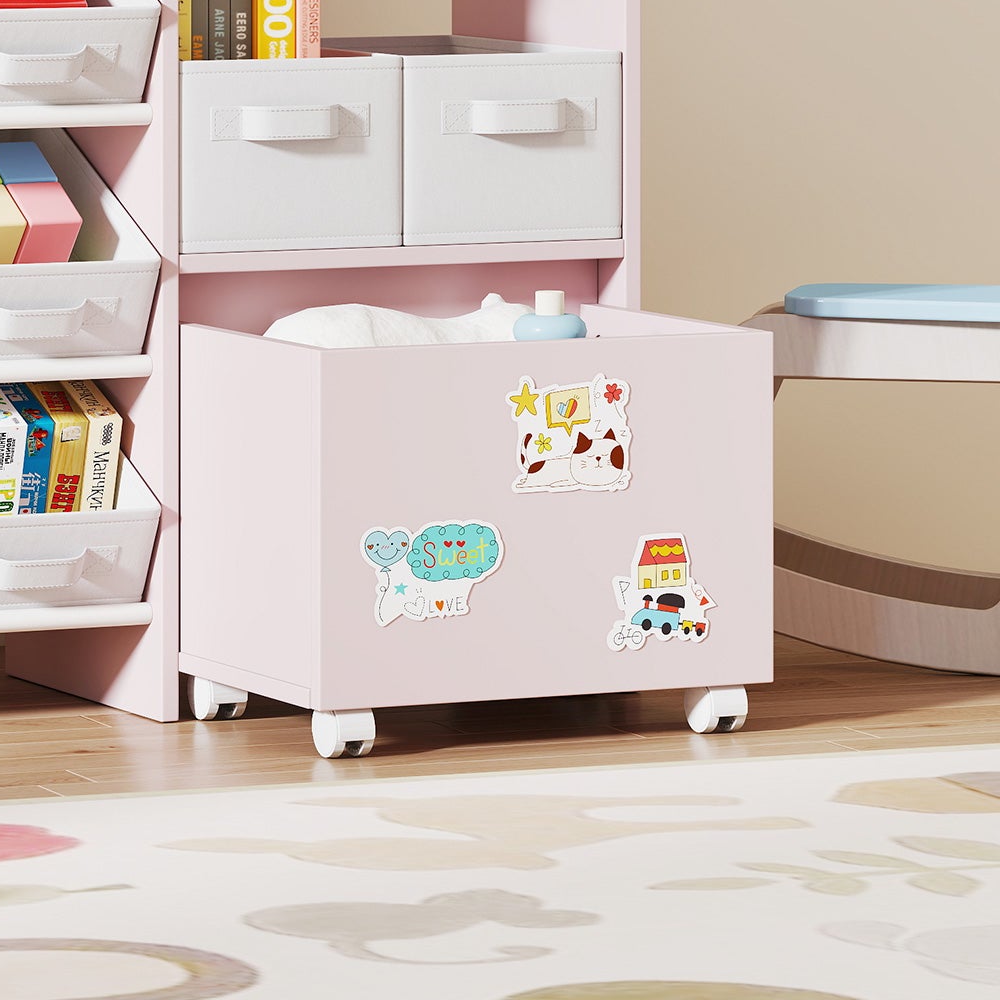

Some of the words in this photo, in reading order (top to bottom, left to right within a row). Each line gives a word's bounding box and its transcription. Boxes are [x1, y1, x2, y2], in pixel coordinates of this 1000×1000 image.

[214, 8, 225, 38] ARNE
[236, 12, 247, 40] EERO
[50, 474, 80, 512] БЭНГ
[423, 537, 488, 568] Sweet
